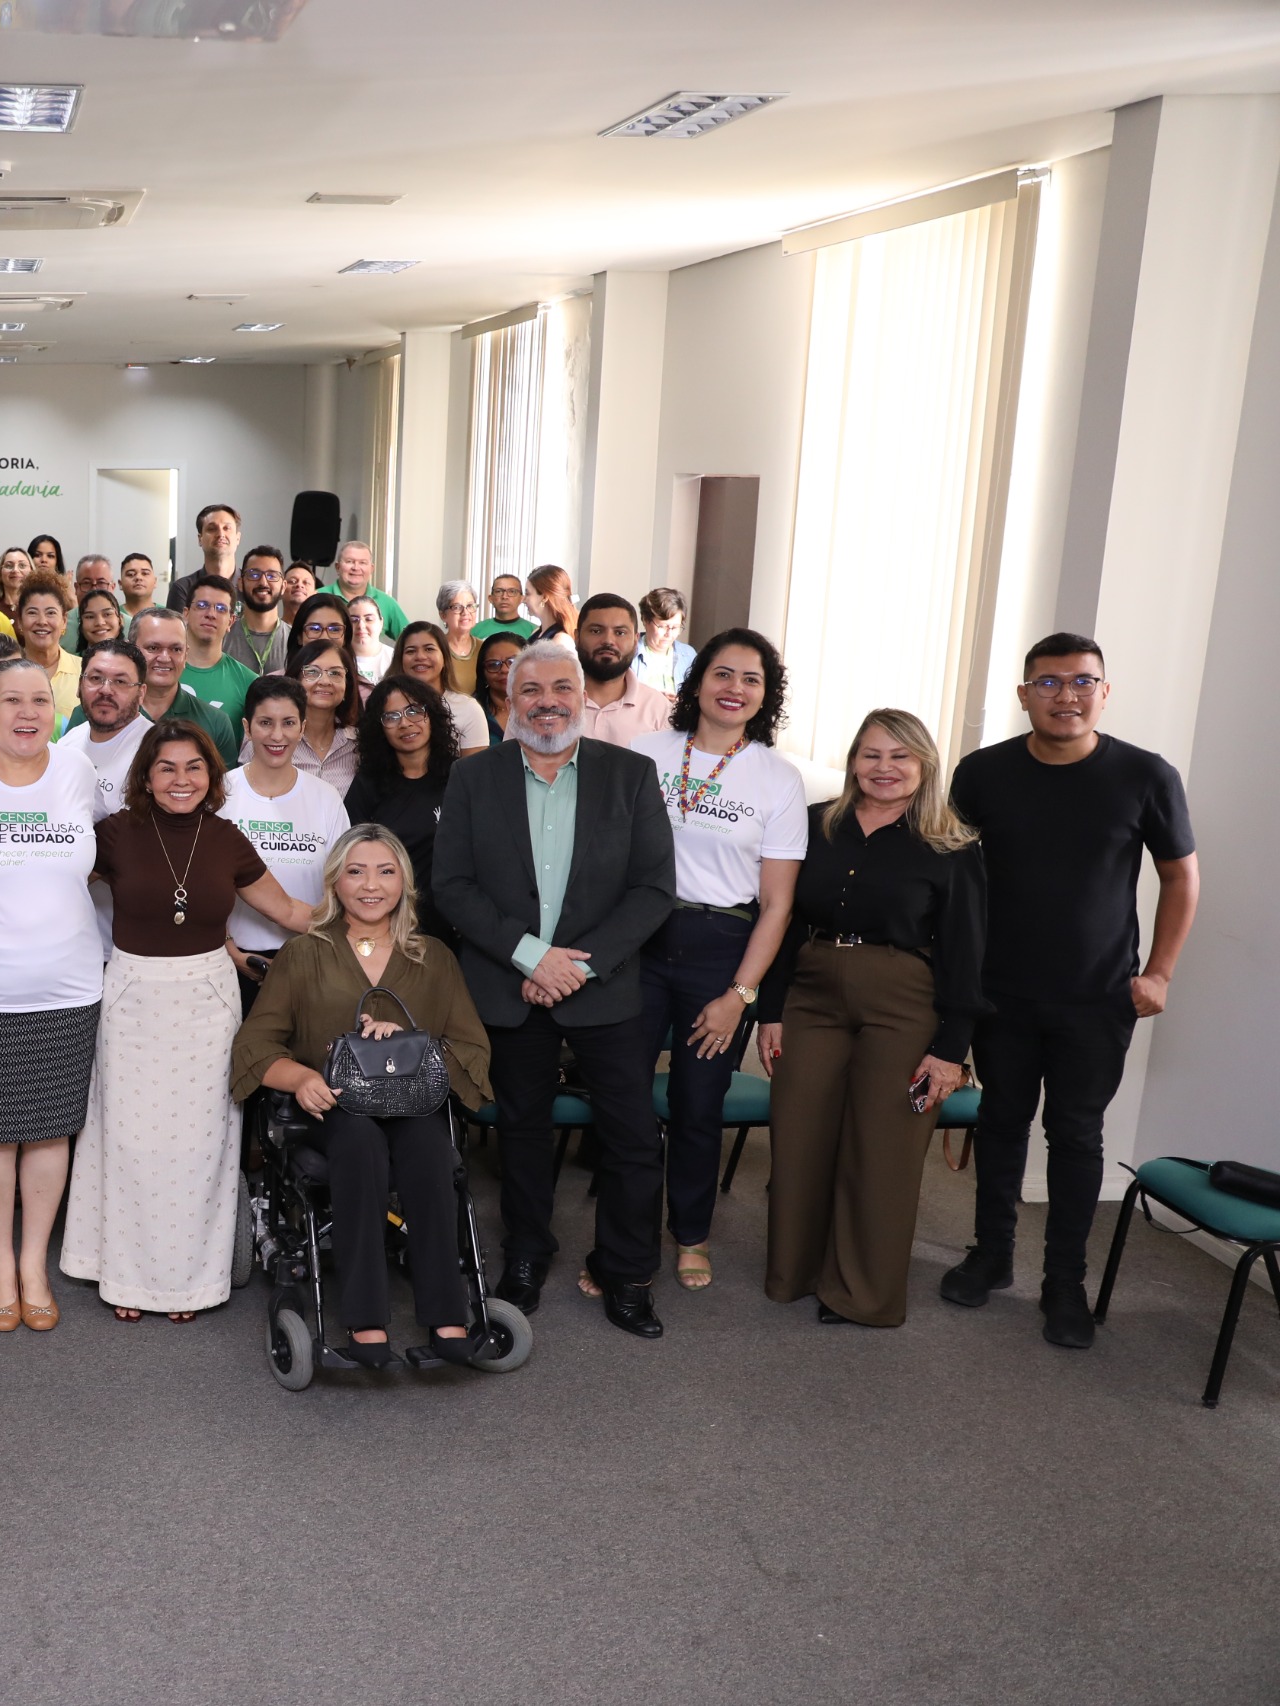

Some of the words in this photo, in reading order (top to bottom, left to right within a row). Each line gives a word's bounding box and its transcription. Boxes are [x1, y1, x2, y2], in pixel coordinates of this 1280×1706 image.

[665, 797, 675, 807] E
[690, 791, 755, 817] ICLUSÃO
[0, 823, 17, 833] DE
[21, 822, 84, 834] INCLUSÃO
[250, 821, 291, 832] CENSO
[691, 819, 733, 835] respeitar
[0, 833, 7, 843] E
[10, 833, 75, 844] CUIDADO
[250, 831, 266, 841] DE
[269, 831, 326, 845] INCLUSÃO
[260, 841, 317, 853] CUIDADO
[30, 848, 74, 859] respeitar
